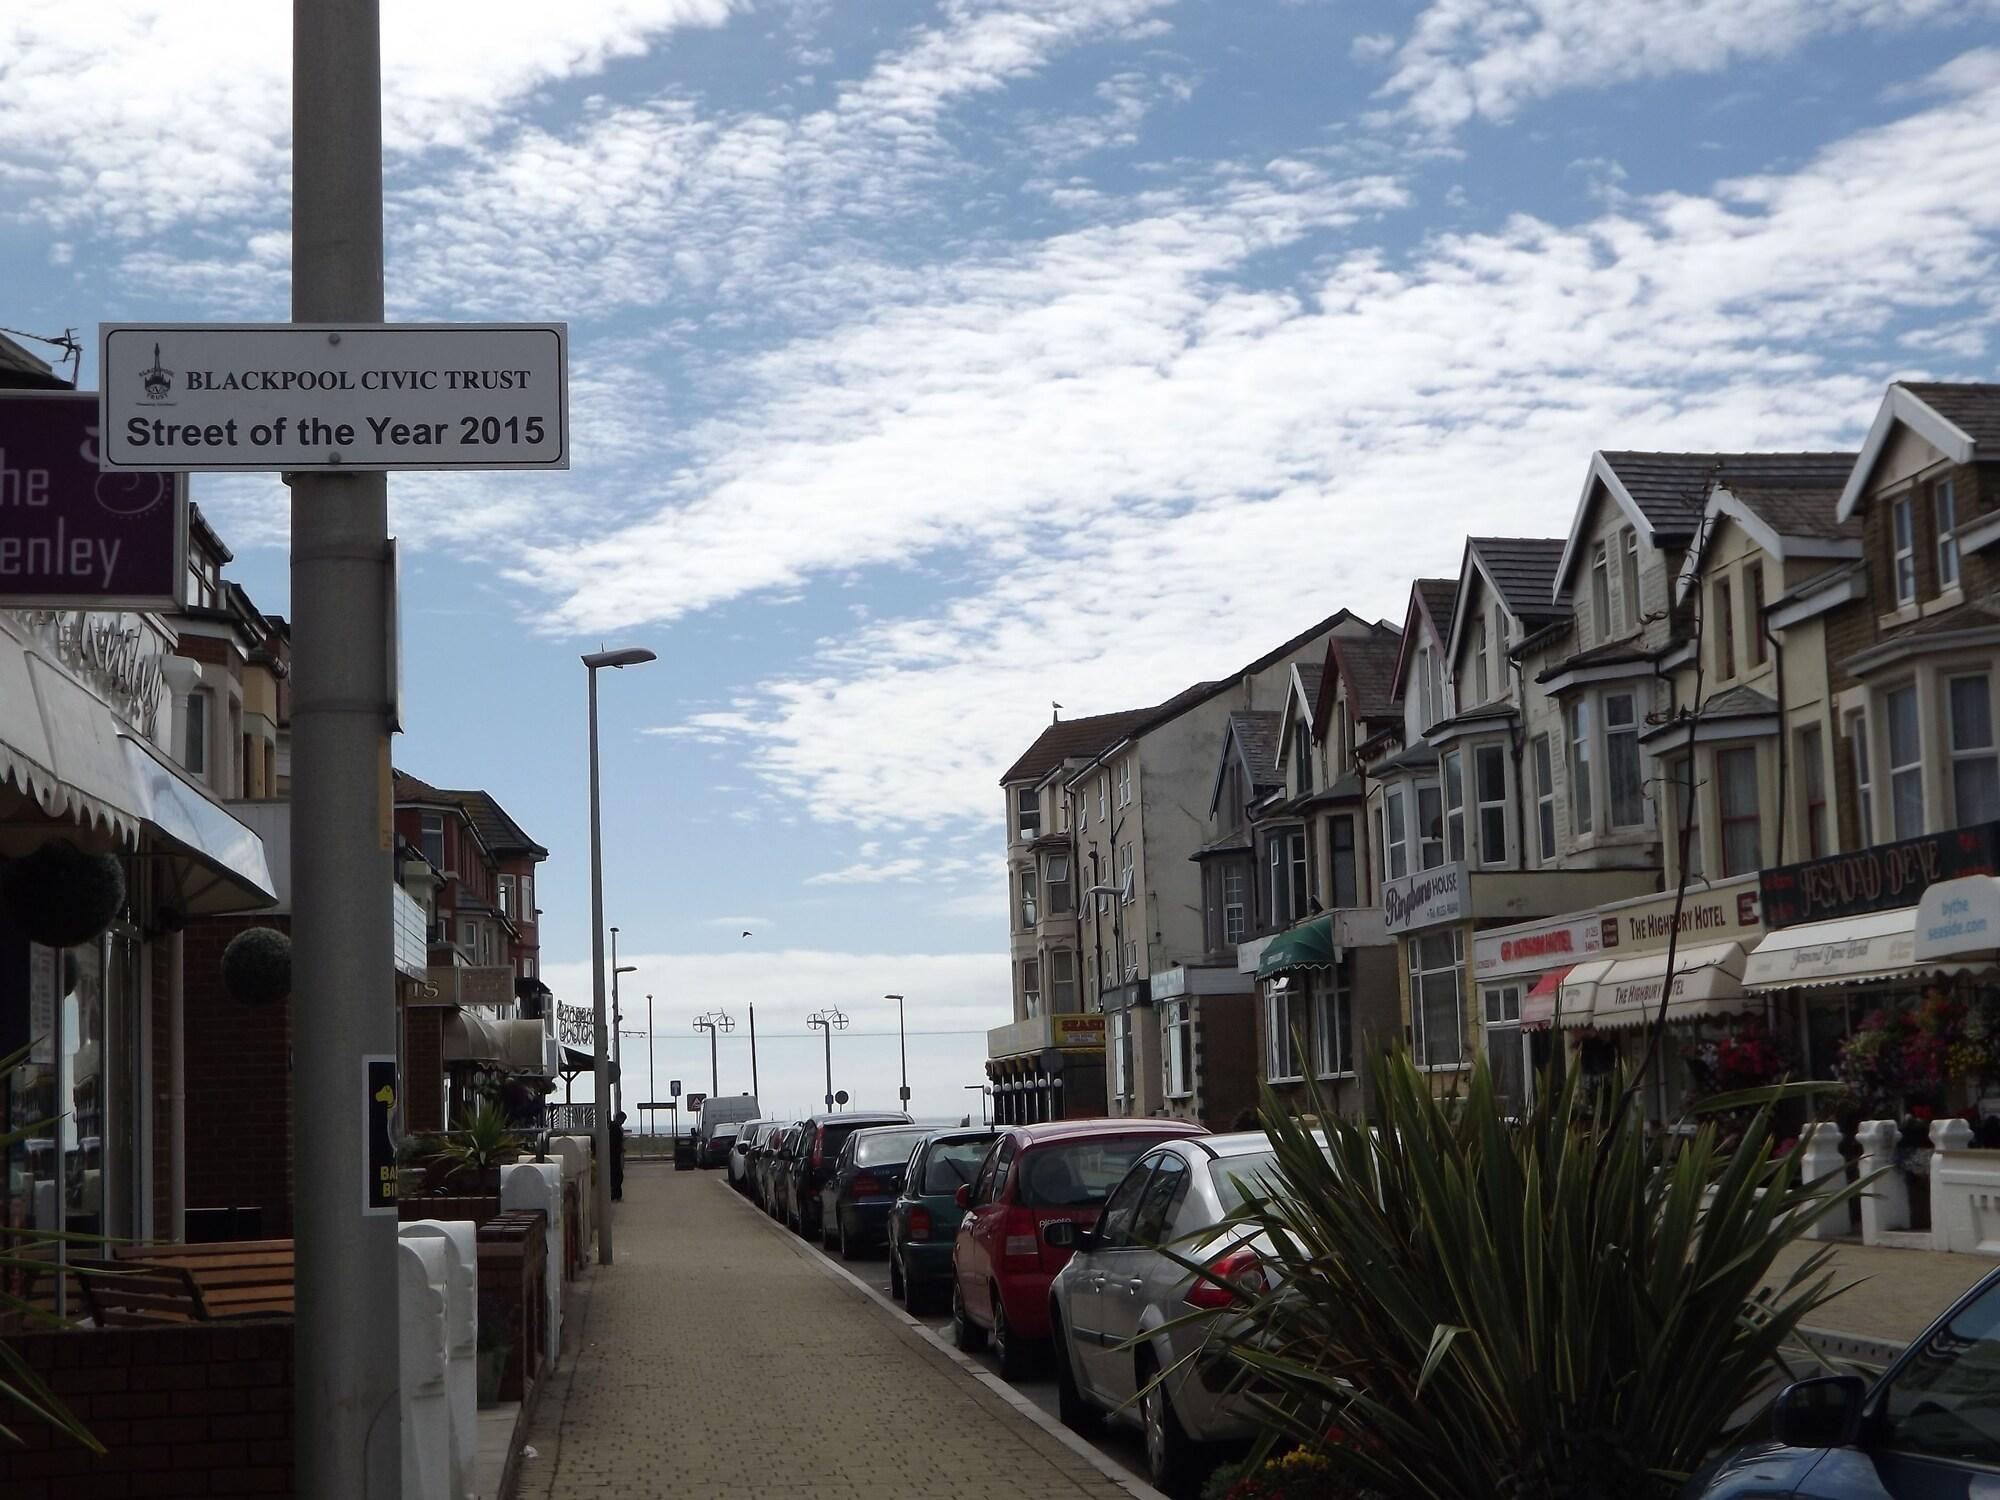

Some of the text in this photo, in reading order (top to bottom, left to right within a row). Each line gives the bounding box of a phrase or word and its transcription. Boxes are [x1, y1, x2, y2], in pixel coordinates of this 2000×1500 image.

[186, 370, 531, 391] BLACKPOOL CIVIC TRUST
[126, 416, 545, 446] Street of the Year 2015
[0, 447, 49, 505] he
[0, 516, 121, 589] enley
[1432, 872, 1458, 896] HOUSE
